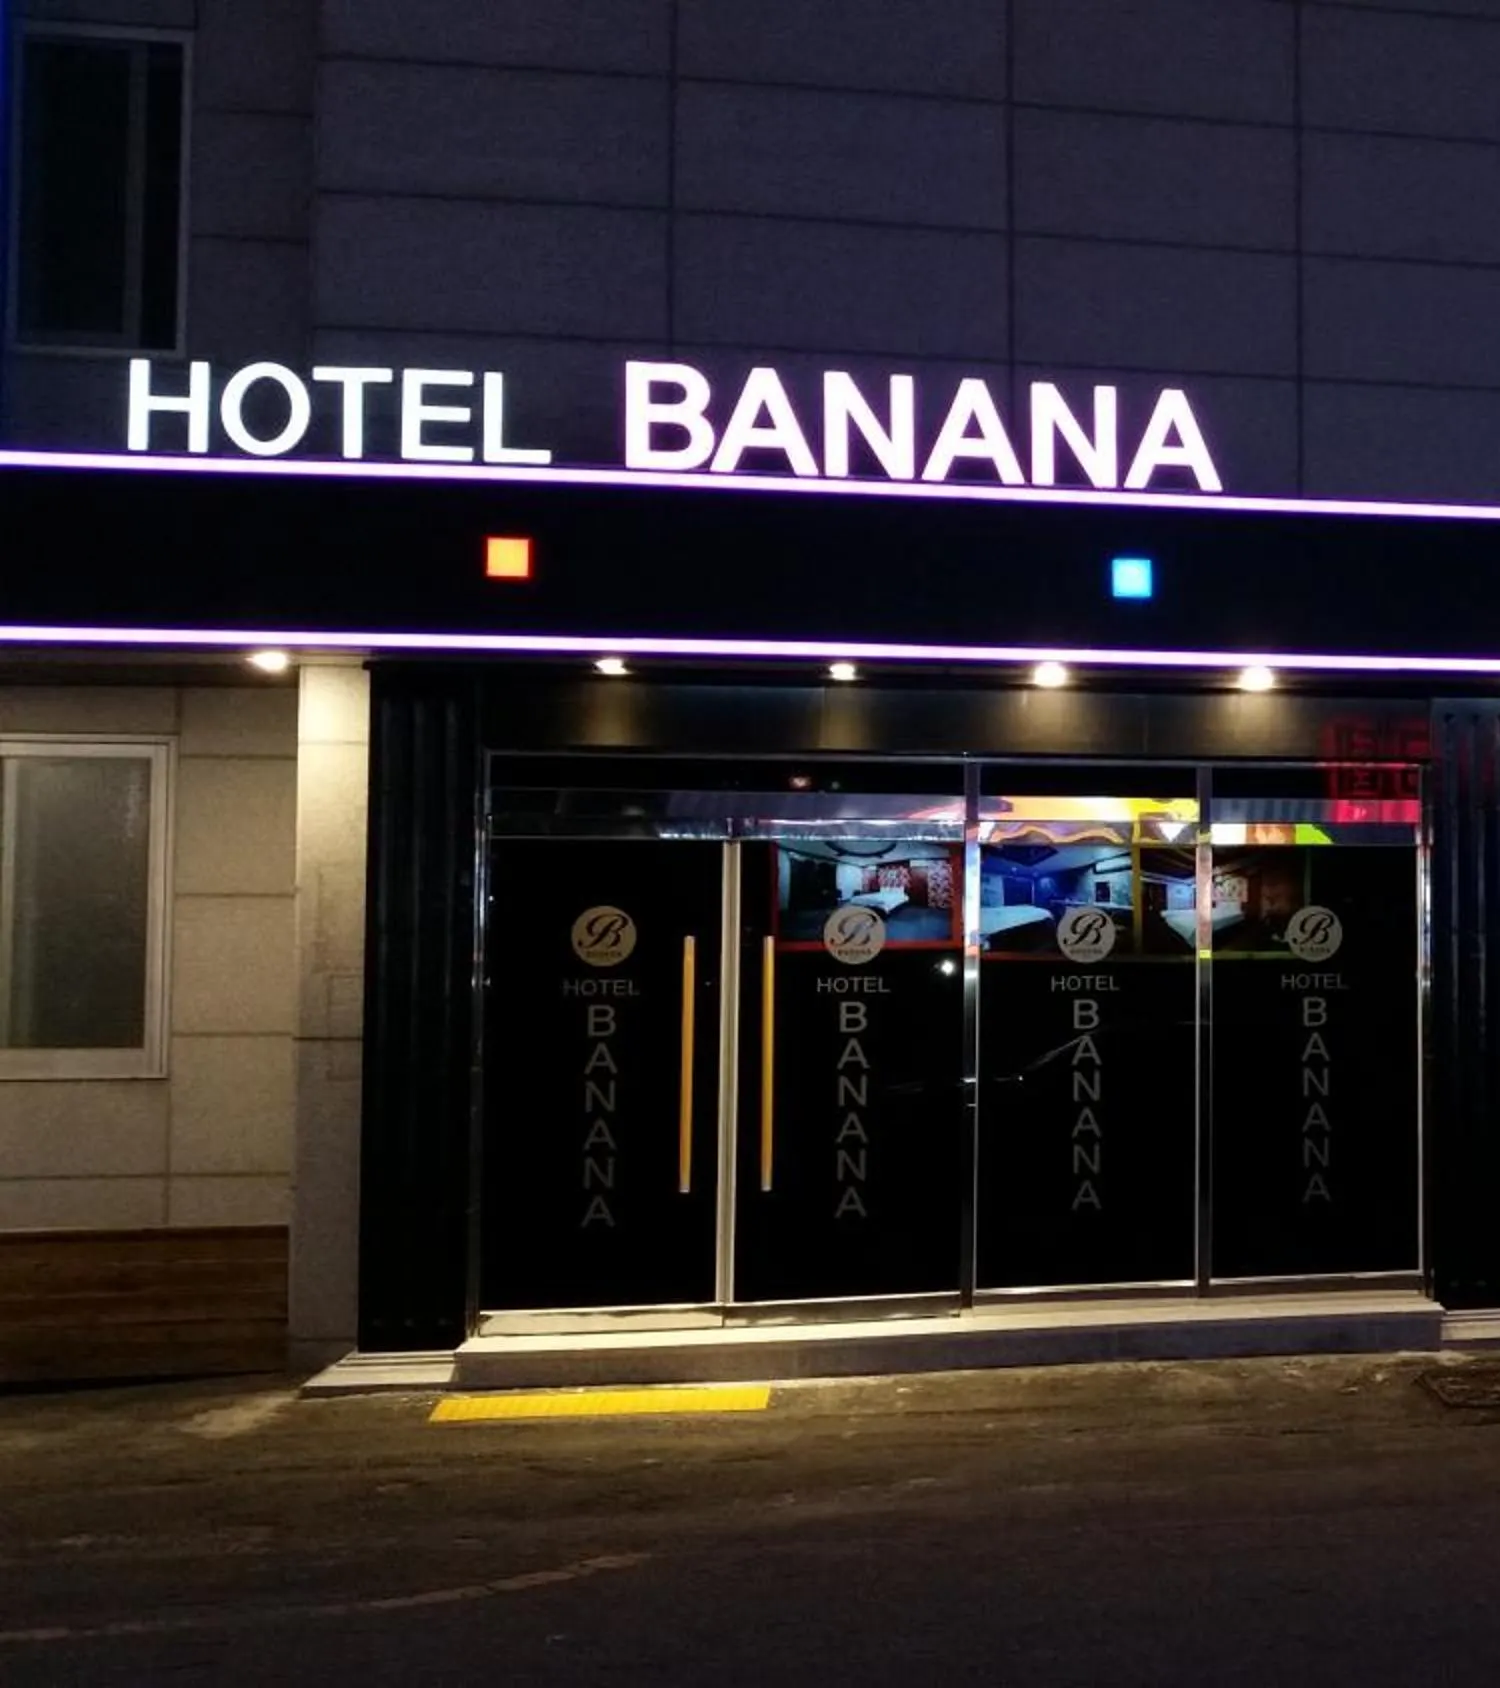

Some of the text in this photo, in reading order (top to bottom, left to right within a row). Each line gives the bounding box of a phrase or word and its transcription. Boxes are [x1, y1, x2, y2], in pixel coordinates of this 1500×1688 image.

[127, 358, 1223, 492] HOTEL BANANA
[563, 978, 640, 997] HOTEL
[816, 975, 891, 994] HOTEL
[1050, 974, 1120, 993] HOTEL
[1281, 972, 1347, 990] HOTEL
[581, 1003, 618, 1227] BANANA
[835, 1001, 870, 1218] BANANA
[1071, 999, 1102, 1210] BANANA
[1301, 996, 1331, 1201] BANANA
